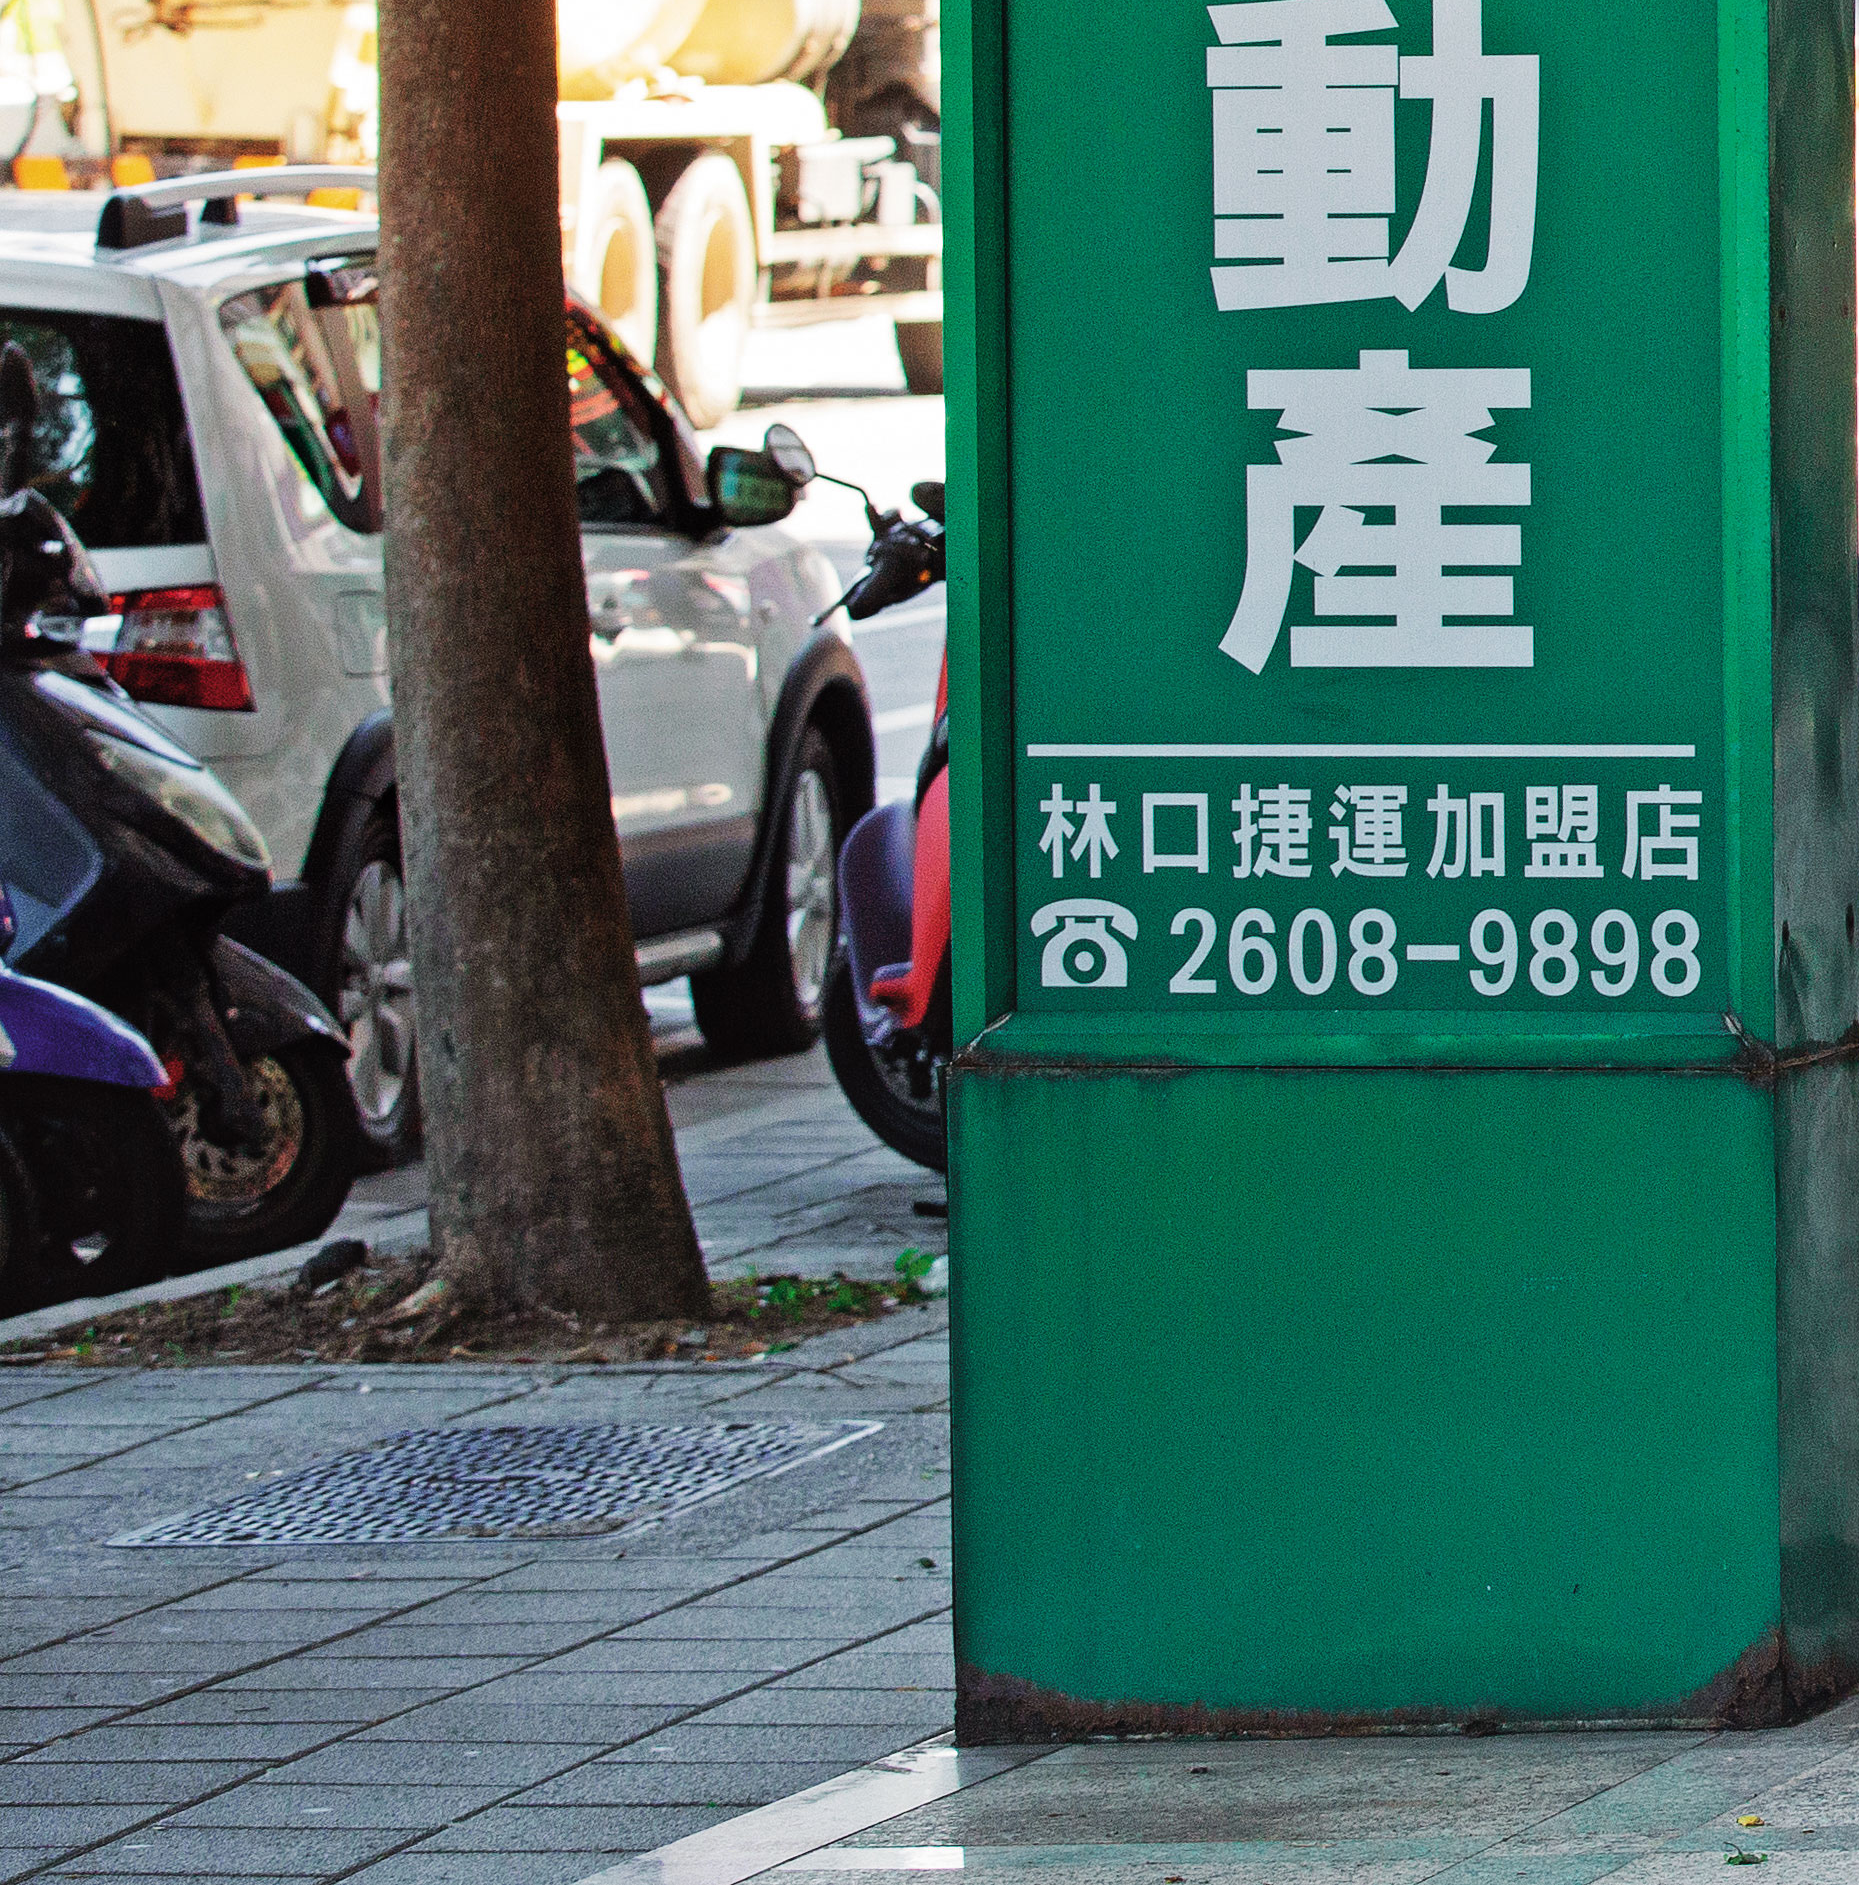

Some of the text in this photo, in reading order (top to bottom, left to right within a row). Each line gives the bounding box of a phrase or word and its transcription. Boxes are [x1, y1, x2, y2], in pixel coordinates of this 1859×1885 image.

[1038, 783, 1704, 882] 林口捷運加盟店
[1168, 906, 1703, 998] 2608-9898
